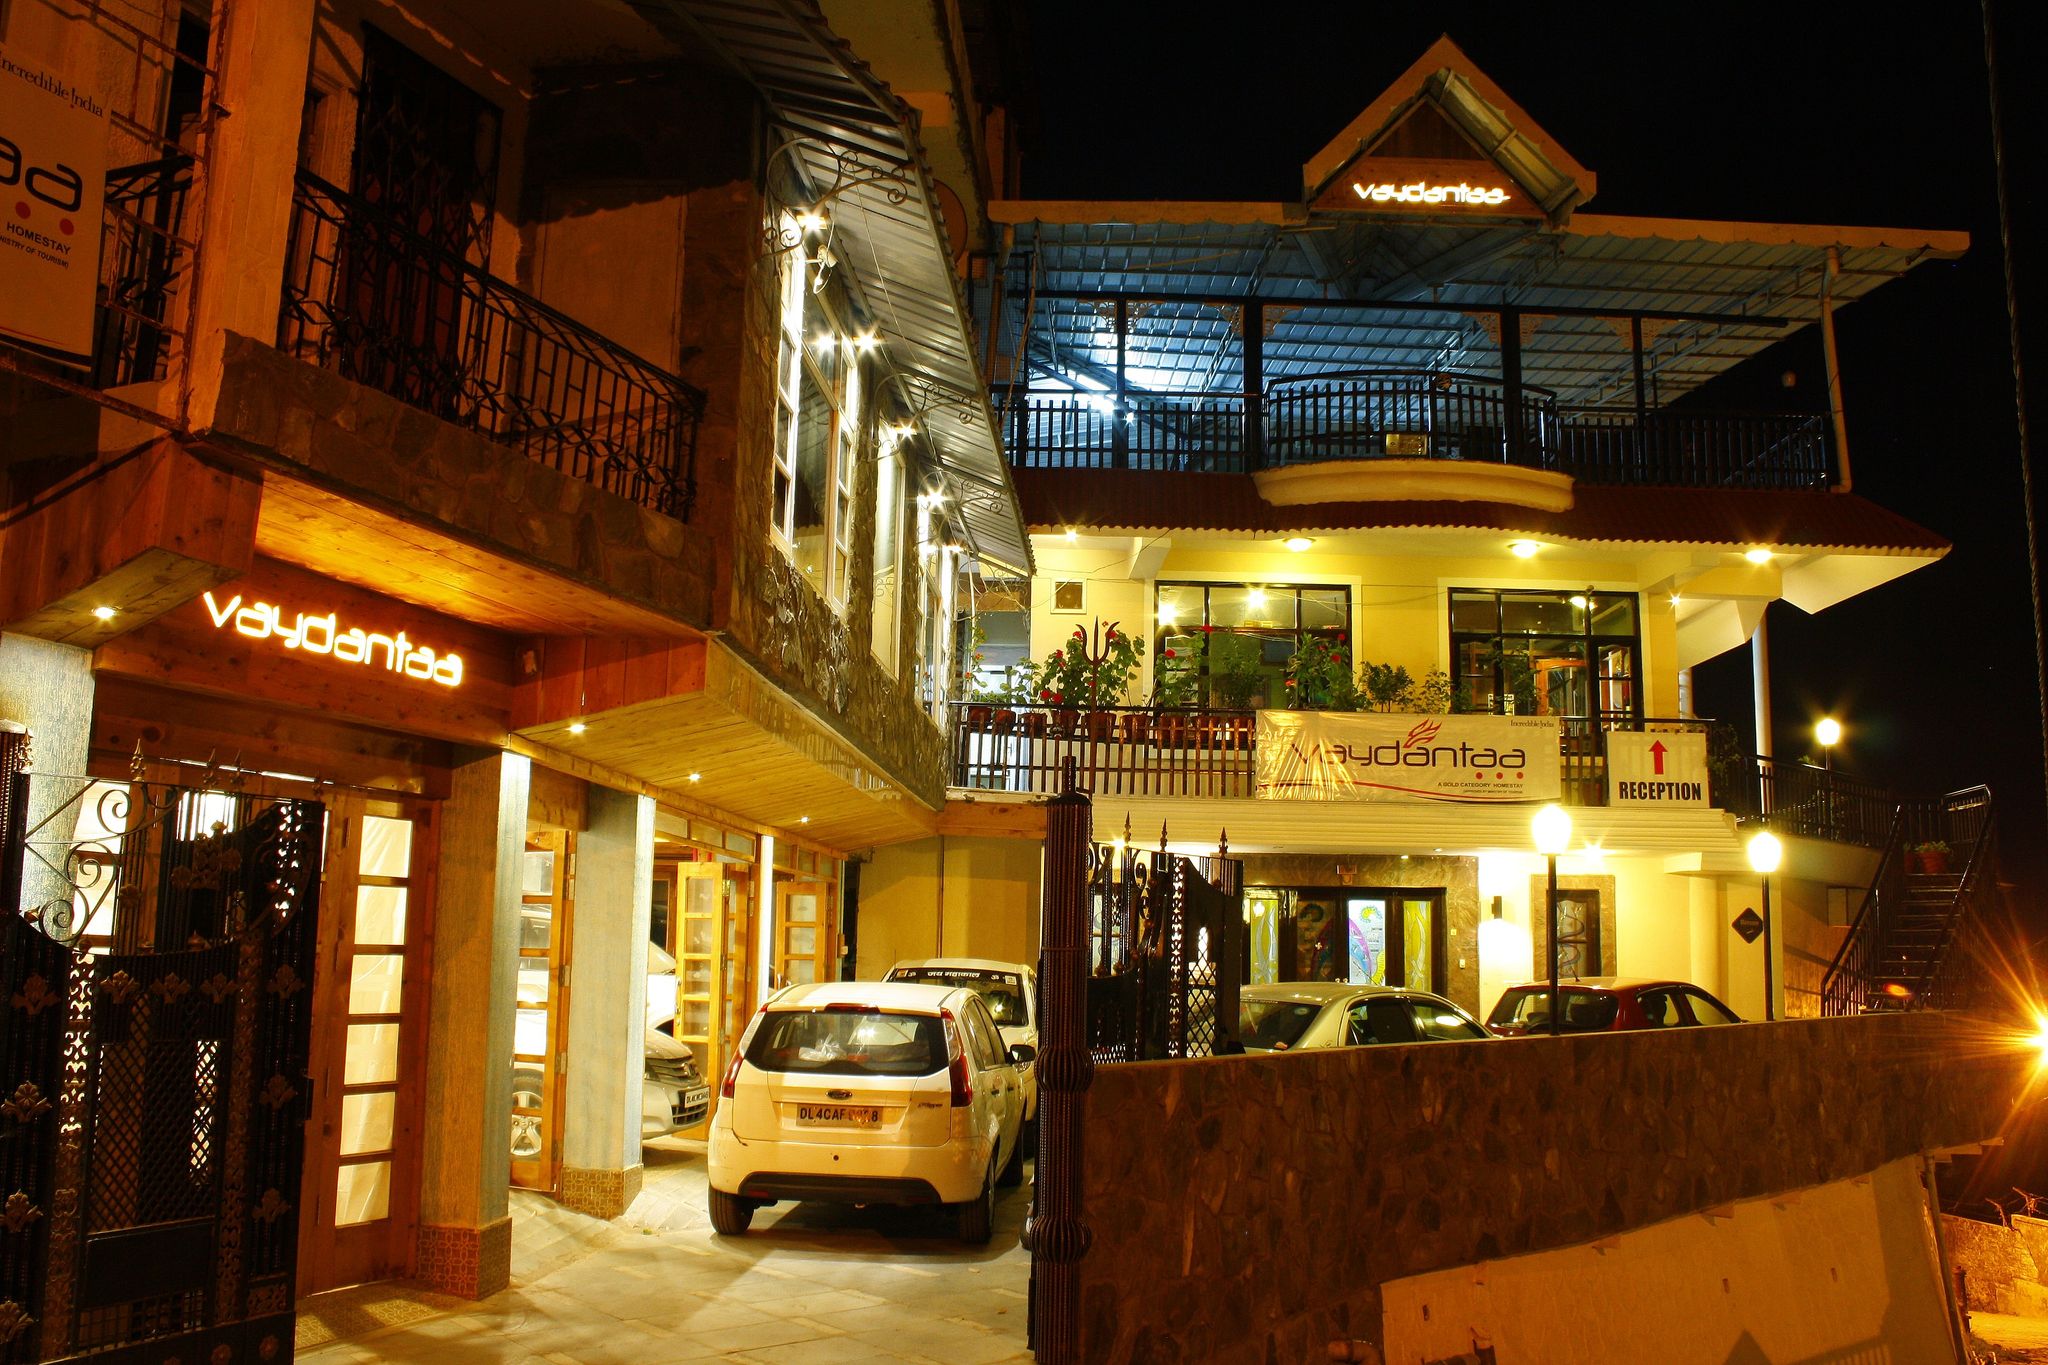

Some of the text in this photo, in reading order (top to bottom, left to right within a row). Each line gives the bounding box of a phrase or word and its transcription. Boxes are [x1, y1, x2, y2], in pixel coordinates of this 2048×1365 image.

[0, 52, 69, 100] ncredible
[7, 221, 71, 255] HOMESTAY
[26, 246, 37, 254] OF
[1619, 781, 1702, 801] RECEPTION
